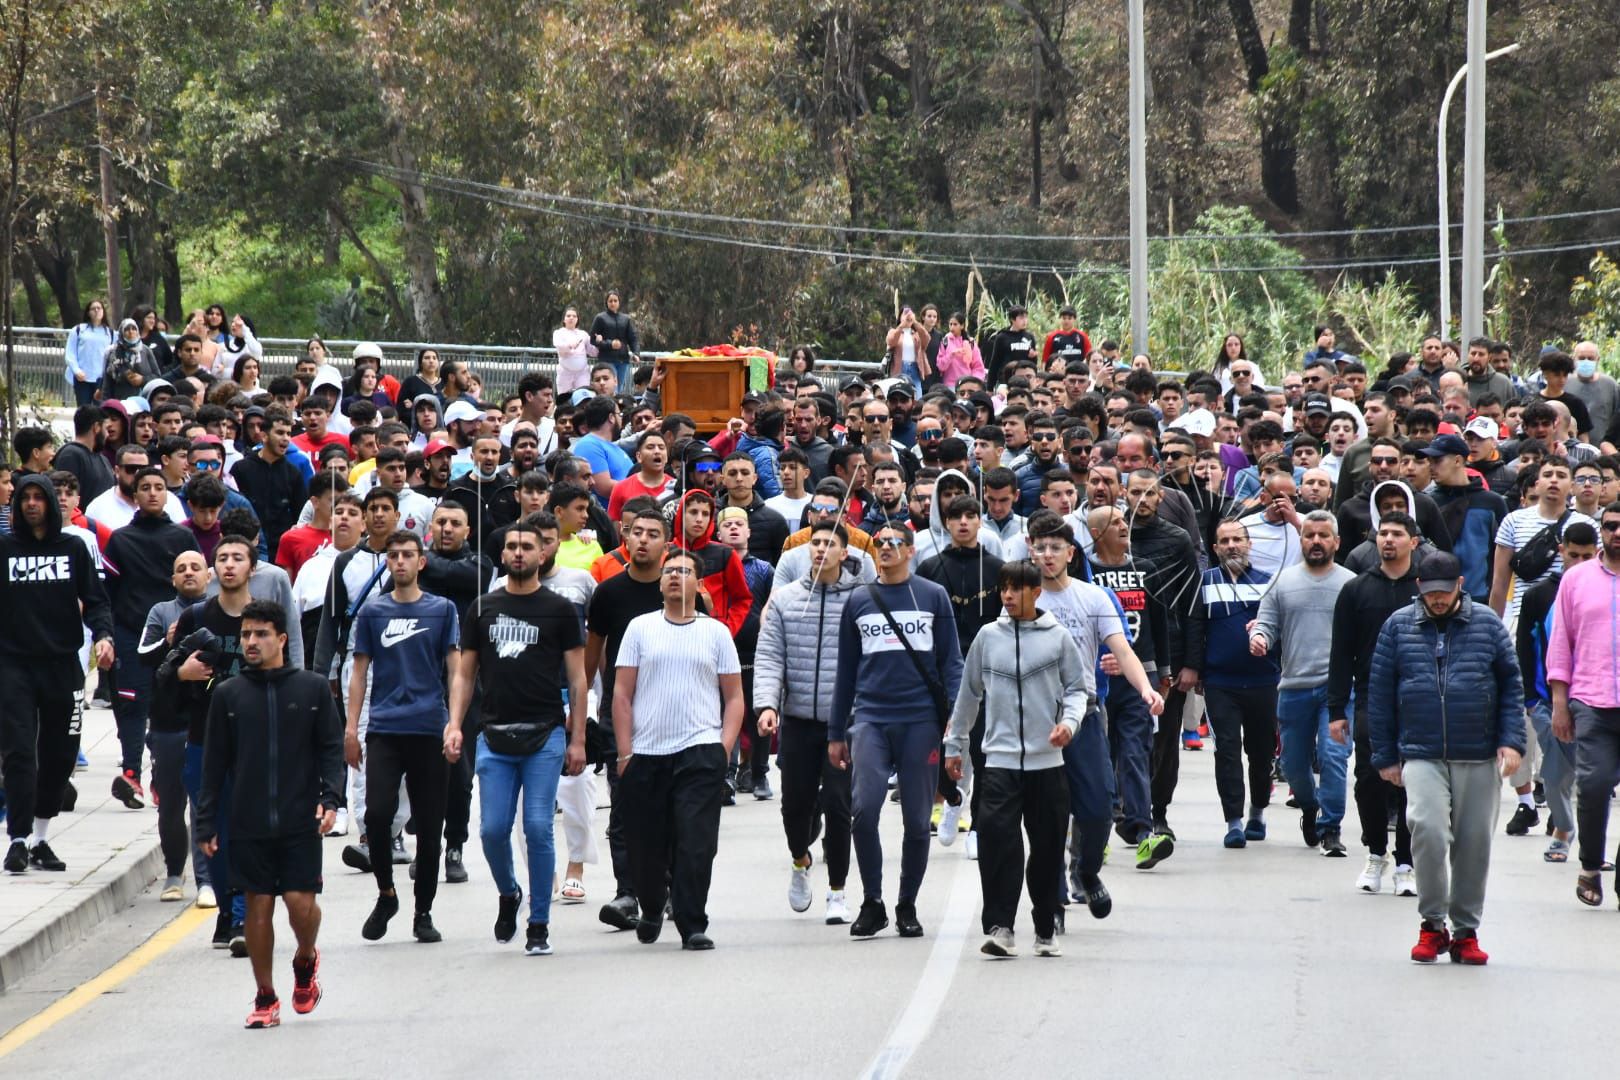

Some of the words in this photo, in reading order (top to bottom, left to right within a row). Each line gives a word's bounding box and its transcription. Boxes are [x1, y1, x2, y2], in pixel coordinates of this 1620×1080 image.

[8, 555, 71, 582] NIKE
[386, 618, 419, 636] NIKE
[489, 624, 539, 645] PUMA
